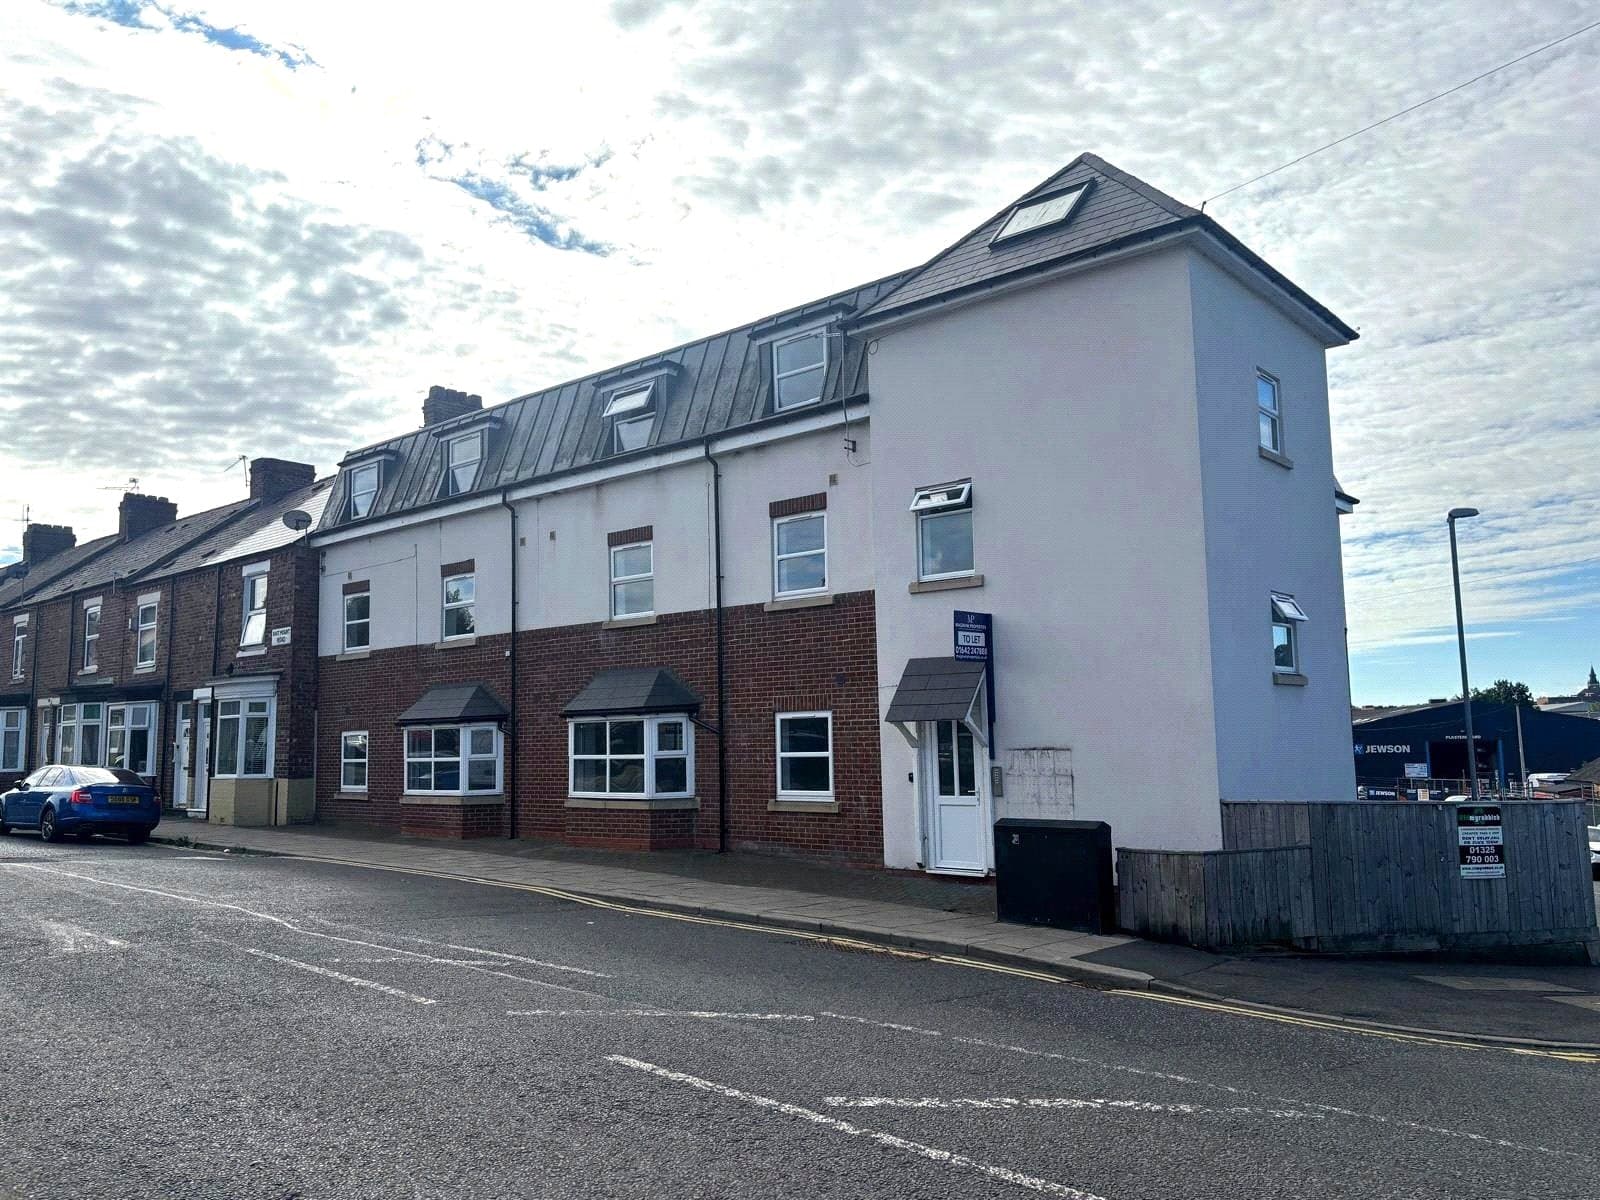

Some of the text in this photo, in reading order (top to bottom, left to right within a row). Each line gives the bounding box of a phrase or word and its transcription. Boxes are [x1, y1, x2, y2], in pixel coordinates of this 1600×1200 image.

[962, 634, 981, 644] TO LET
[1365, 745, 1410, 753] JEWSON
[1469, 846, 1495, 854] 01325
[1466, 855, 1499, 863] 790 003
